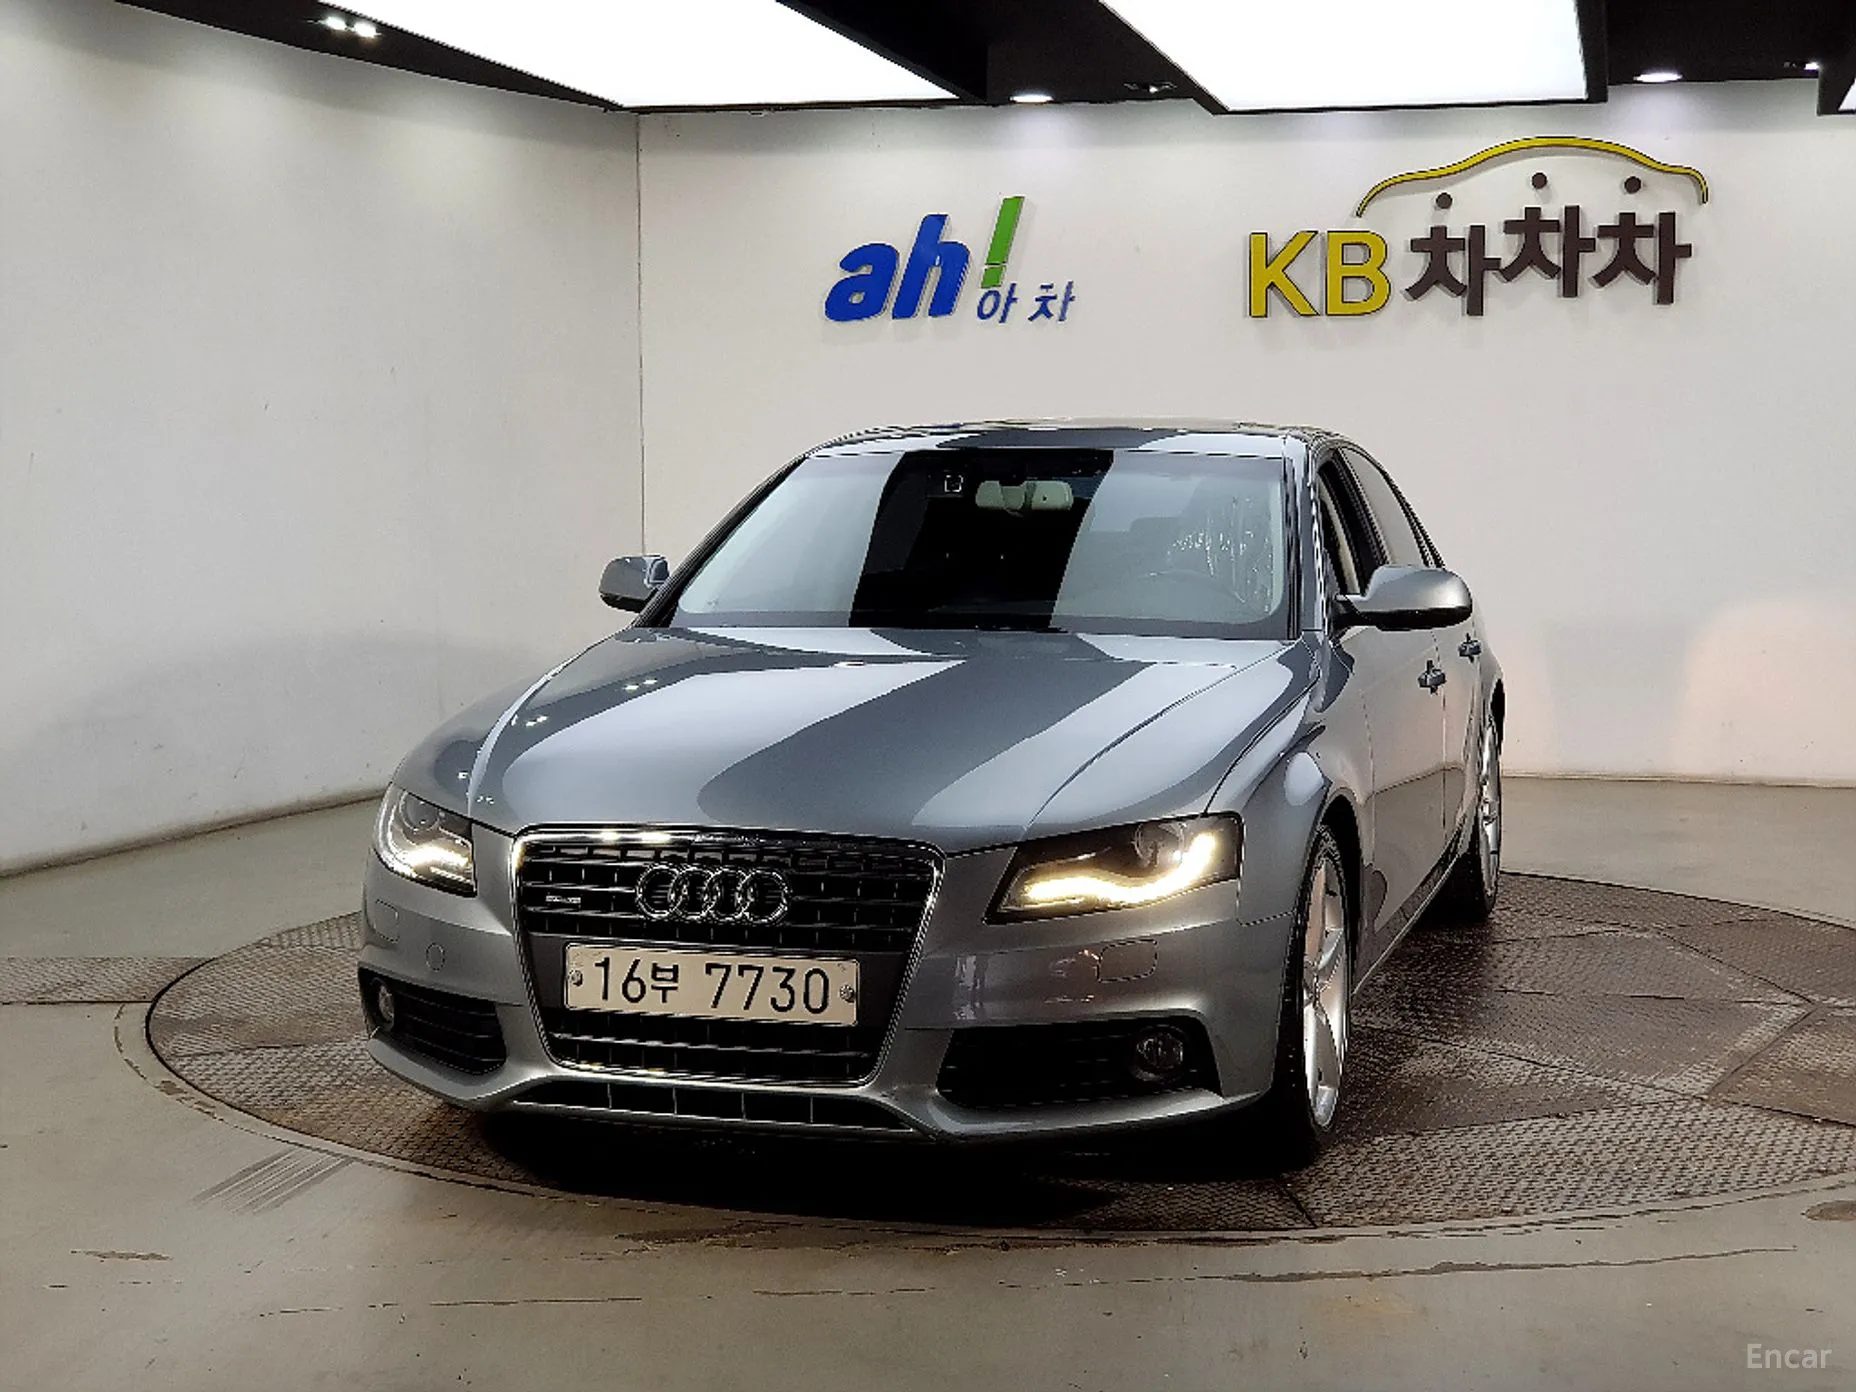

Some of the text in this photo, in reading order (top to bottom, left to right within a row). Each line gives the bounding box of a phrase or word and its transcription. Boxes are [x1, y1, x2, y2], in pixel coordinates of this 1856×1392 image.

[824, 196, 1026, 323] ah!
[594, 957, 830, 1014] 16부 7730
